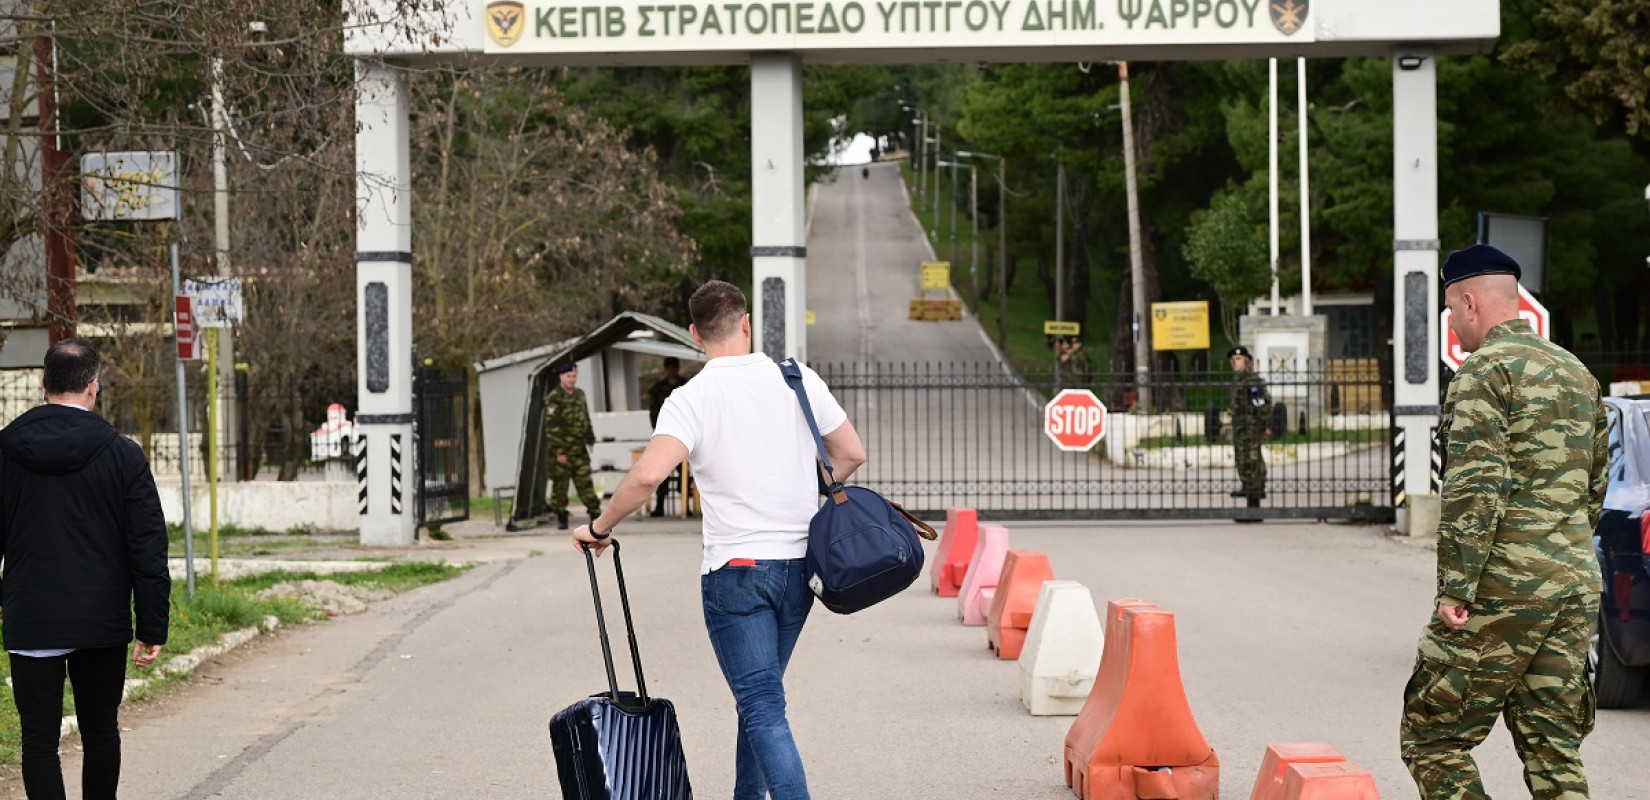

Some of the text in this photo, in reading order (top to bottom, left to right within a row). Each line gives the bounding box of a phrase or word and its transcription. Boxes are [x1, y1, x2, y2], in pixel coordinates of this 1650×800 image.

[536, 0, 1260, 38] ΚΕΠΒ ΣΤΡΑΤΟΠΕΔΟ ΥΠΤΓΟΥ ΔΗΜ. ΨΑΡΡΟΥ
[1051, 405, 1101, 436] STOP
